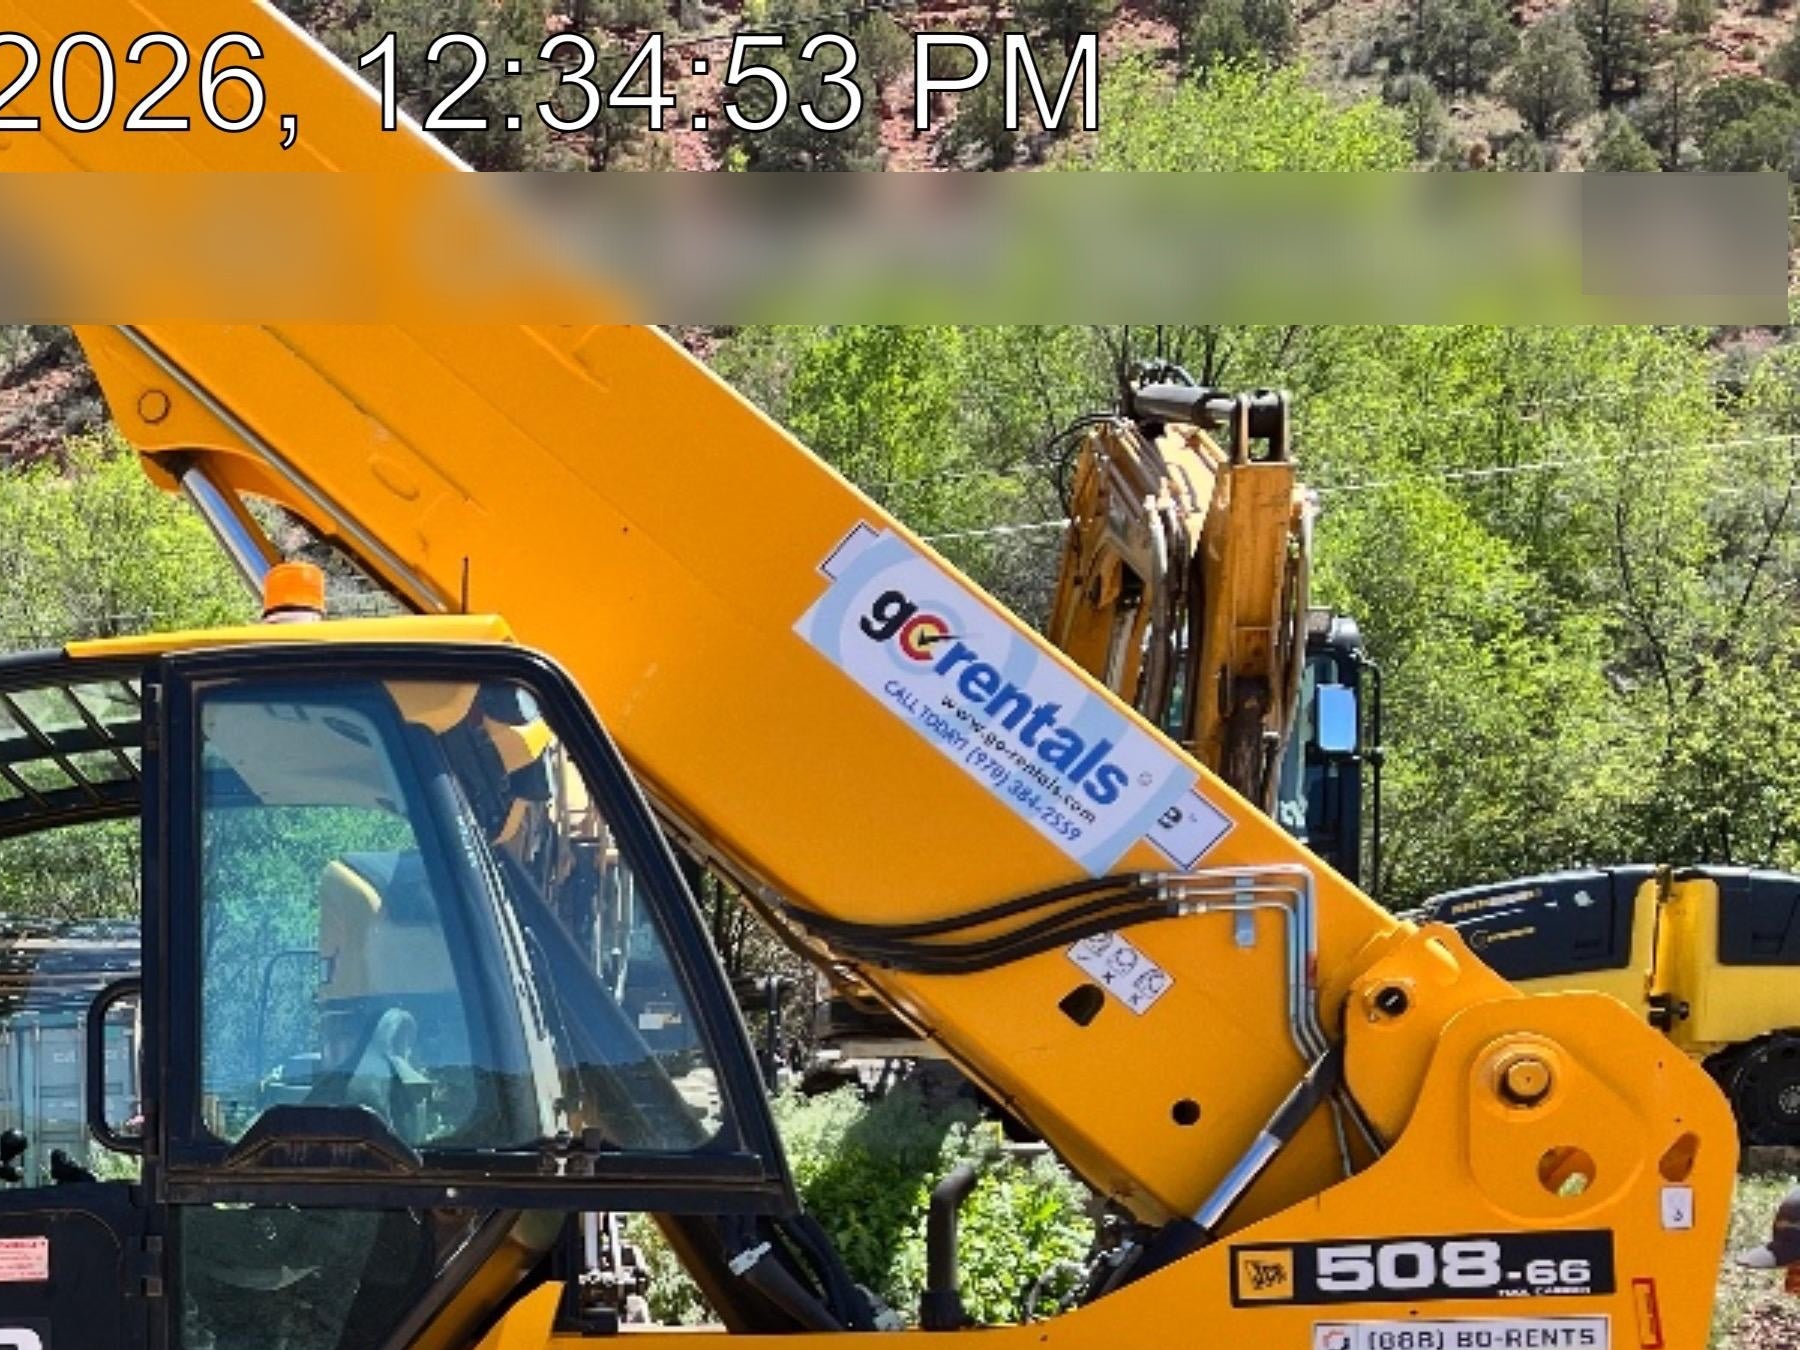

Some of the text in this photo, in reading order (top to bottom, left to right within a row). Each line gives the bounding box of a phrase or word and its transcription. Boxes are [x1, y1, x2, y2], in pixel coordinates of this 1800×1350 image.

[884, 680, 916, 713] CALL
[940, 695, 1097, 824] www.go-rentals.com
[1315, 1240, 1592, 1292] 508-66
